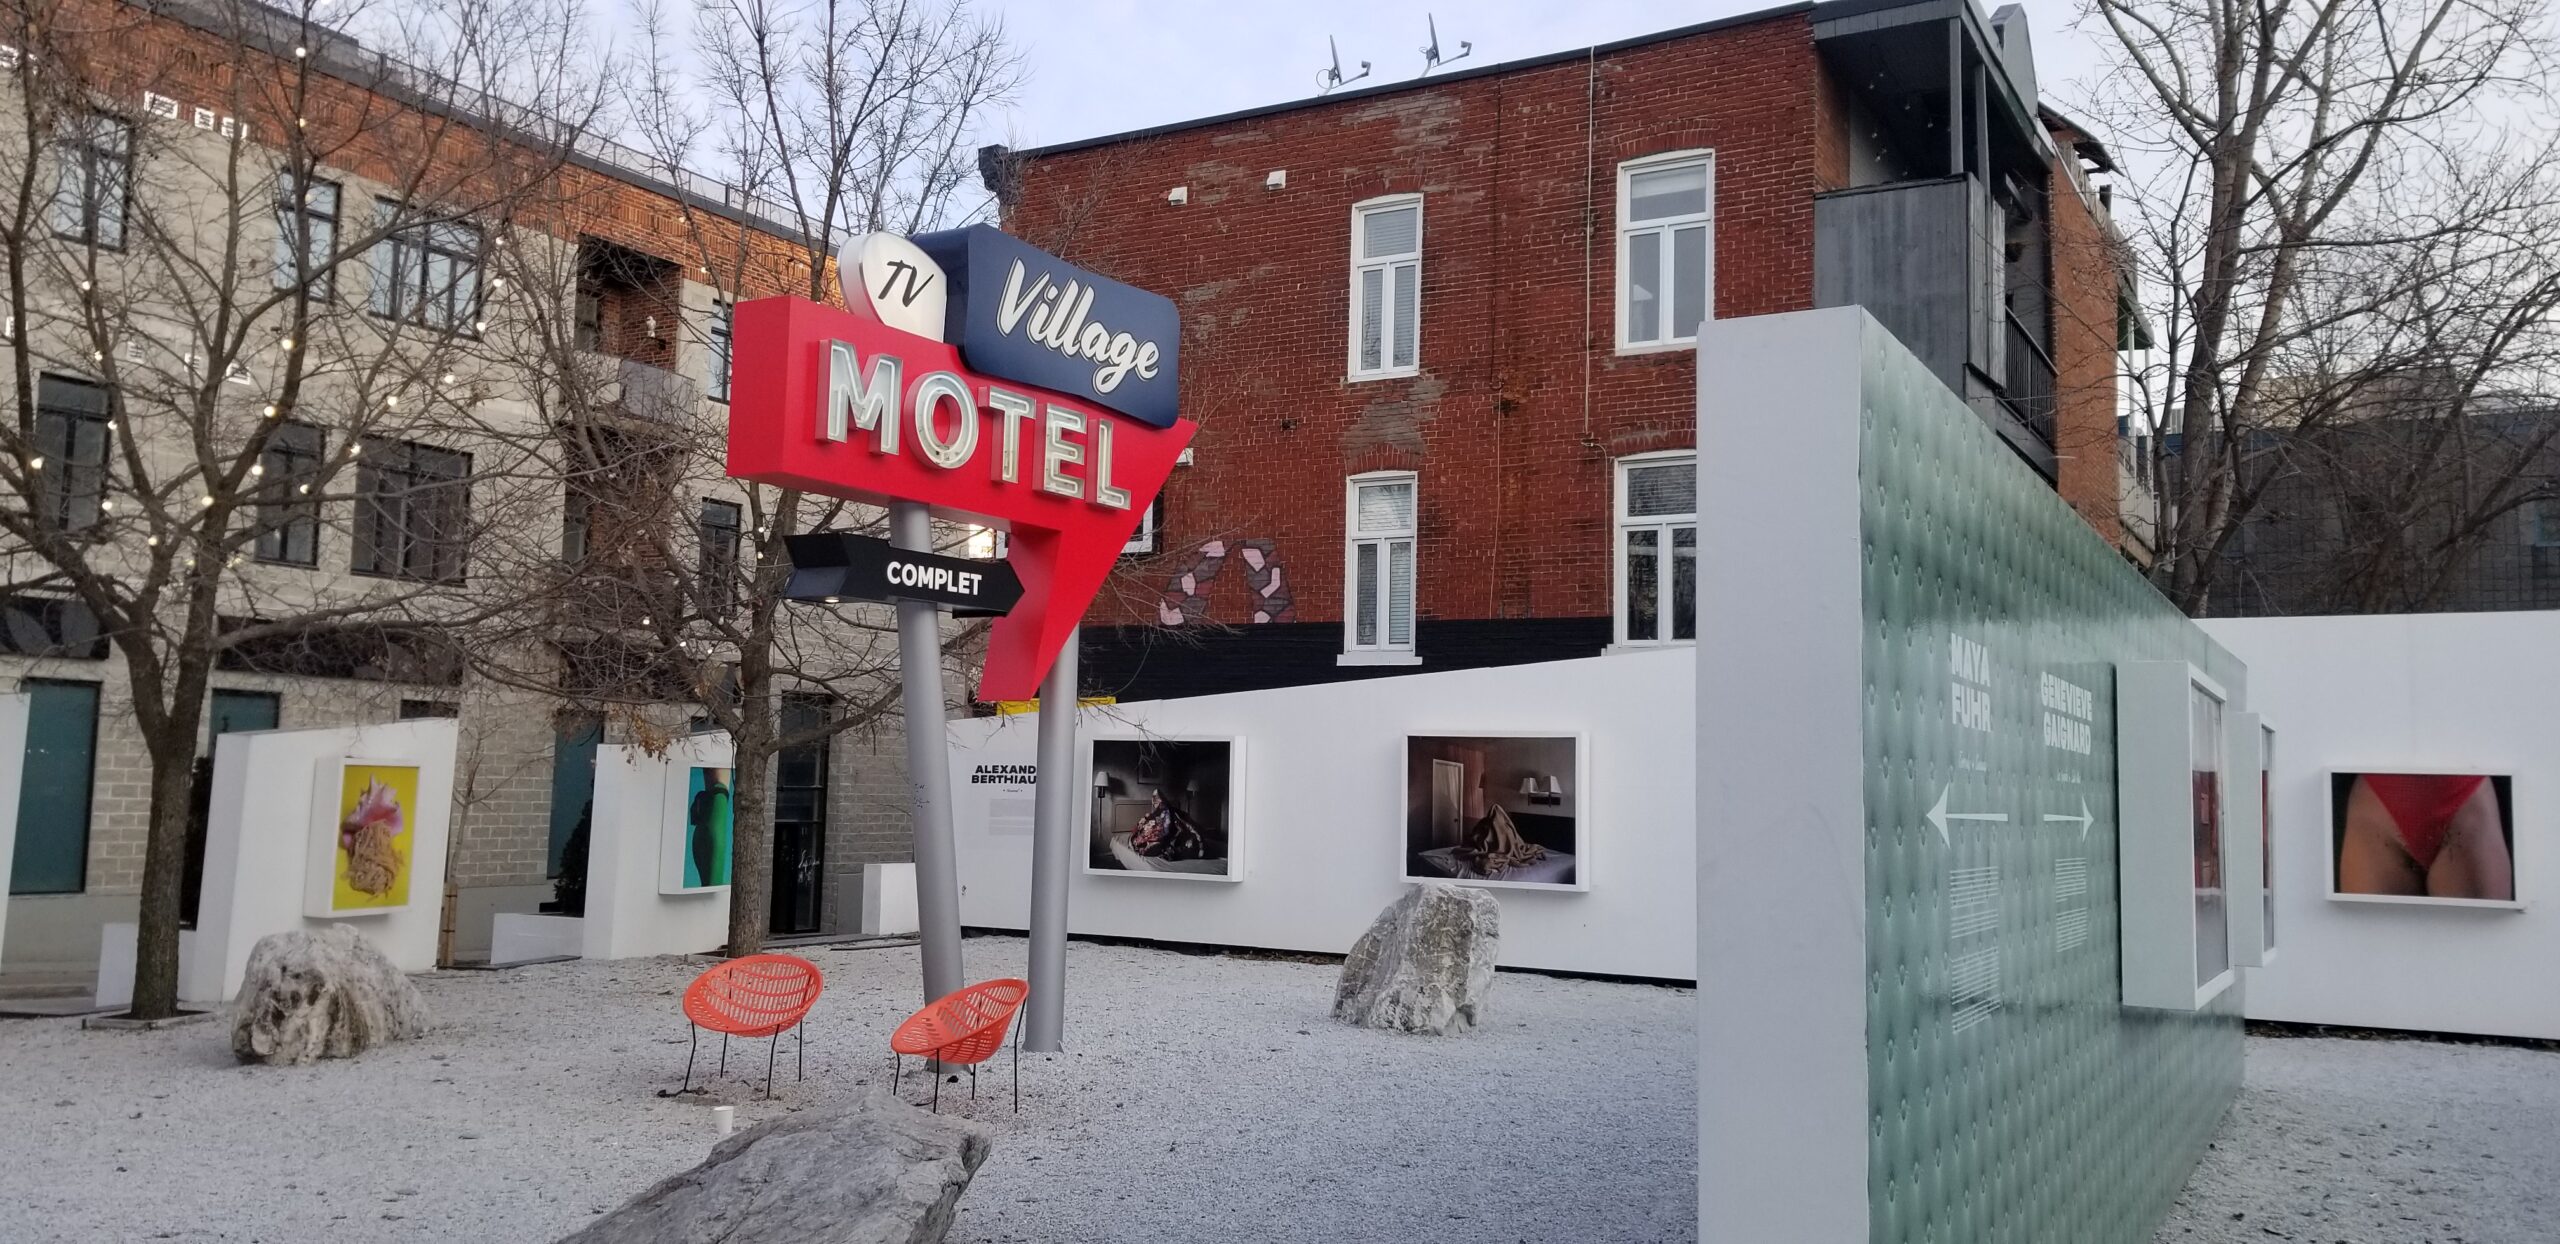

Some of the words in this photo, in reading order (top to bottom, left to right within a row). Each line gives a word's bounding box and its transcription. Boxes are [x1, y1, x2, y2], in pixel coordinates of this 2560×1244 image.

[878, 260, 935, 307] TV
[997, 258, 1160, 395] Village
[817, 339, 1132, 510] MOTEL
[886, 561, 983, 596] COMPLET
[1951, 633, 1991, 686] MAYA
[1952, 682, 1992, 732] FUHR
[2043, 711, 2092, 756] GAIGNARD
